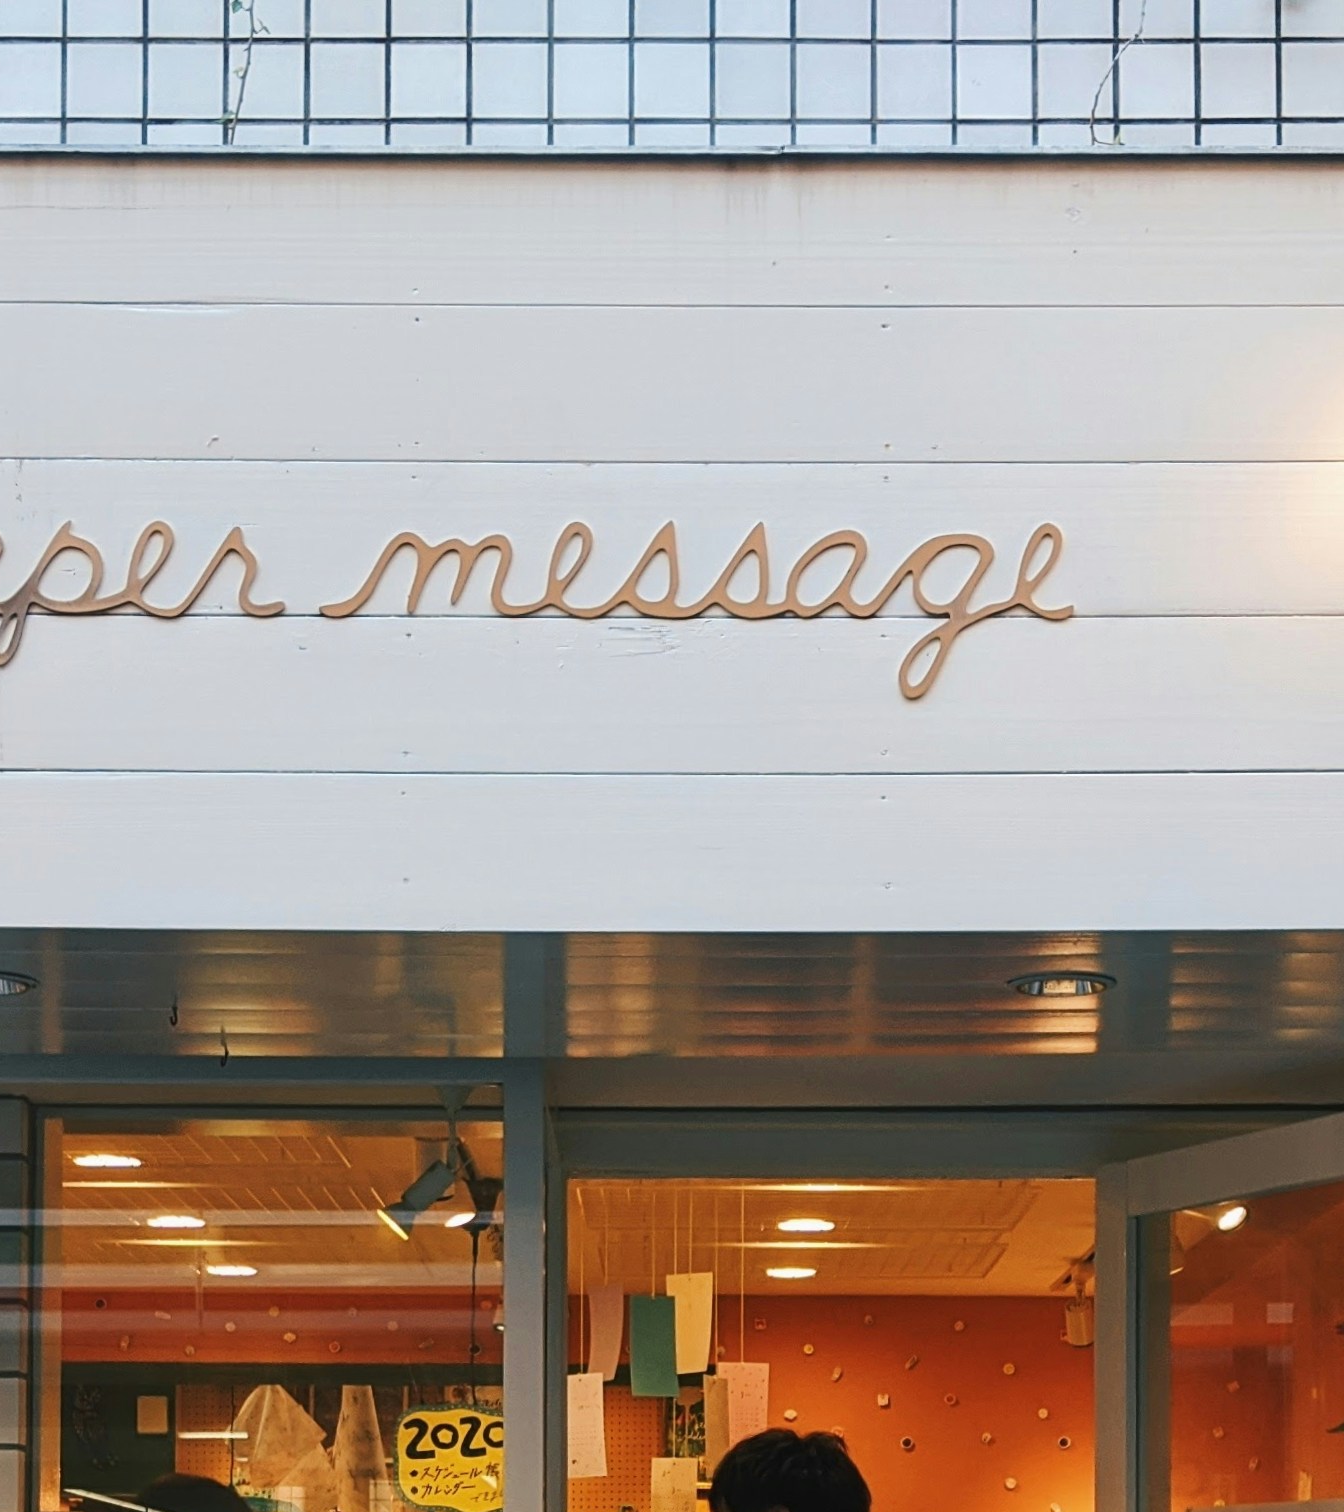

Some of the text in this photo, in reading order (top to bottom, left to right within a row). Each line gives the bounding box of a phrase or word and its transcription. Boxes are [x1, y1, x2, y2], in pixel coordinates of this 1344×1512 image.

[320, 520, 1076, 700] message
[421, 1481, 477, 1499] カレンダー
